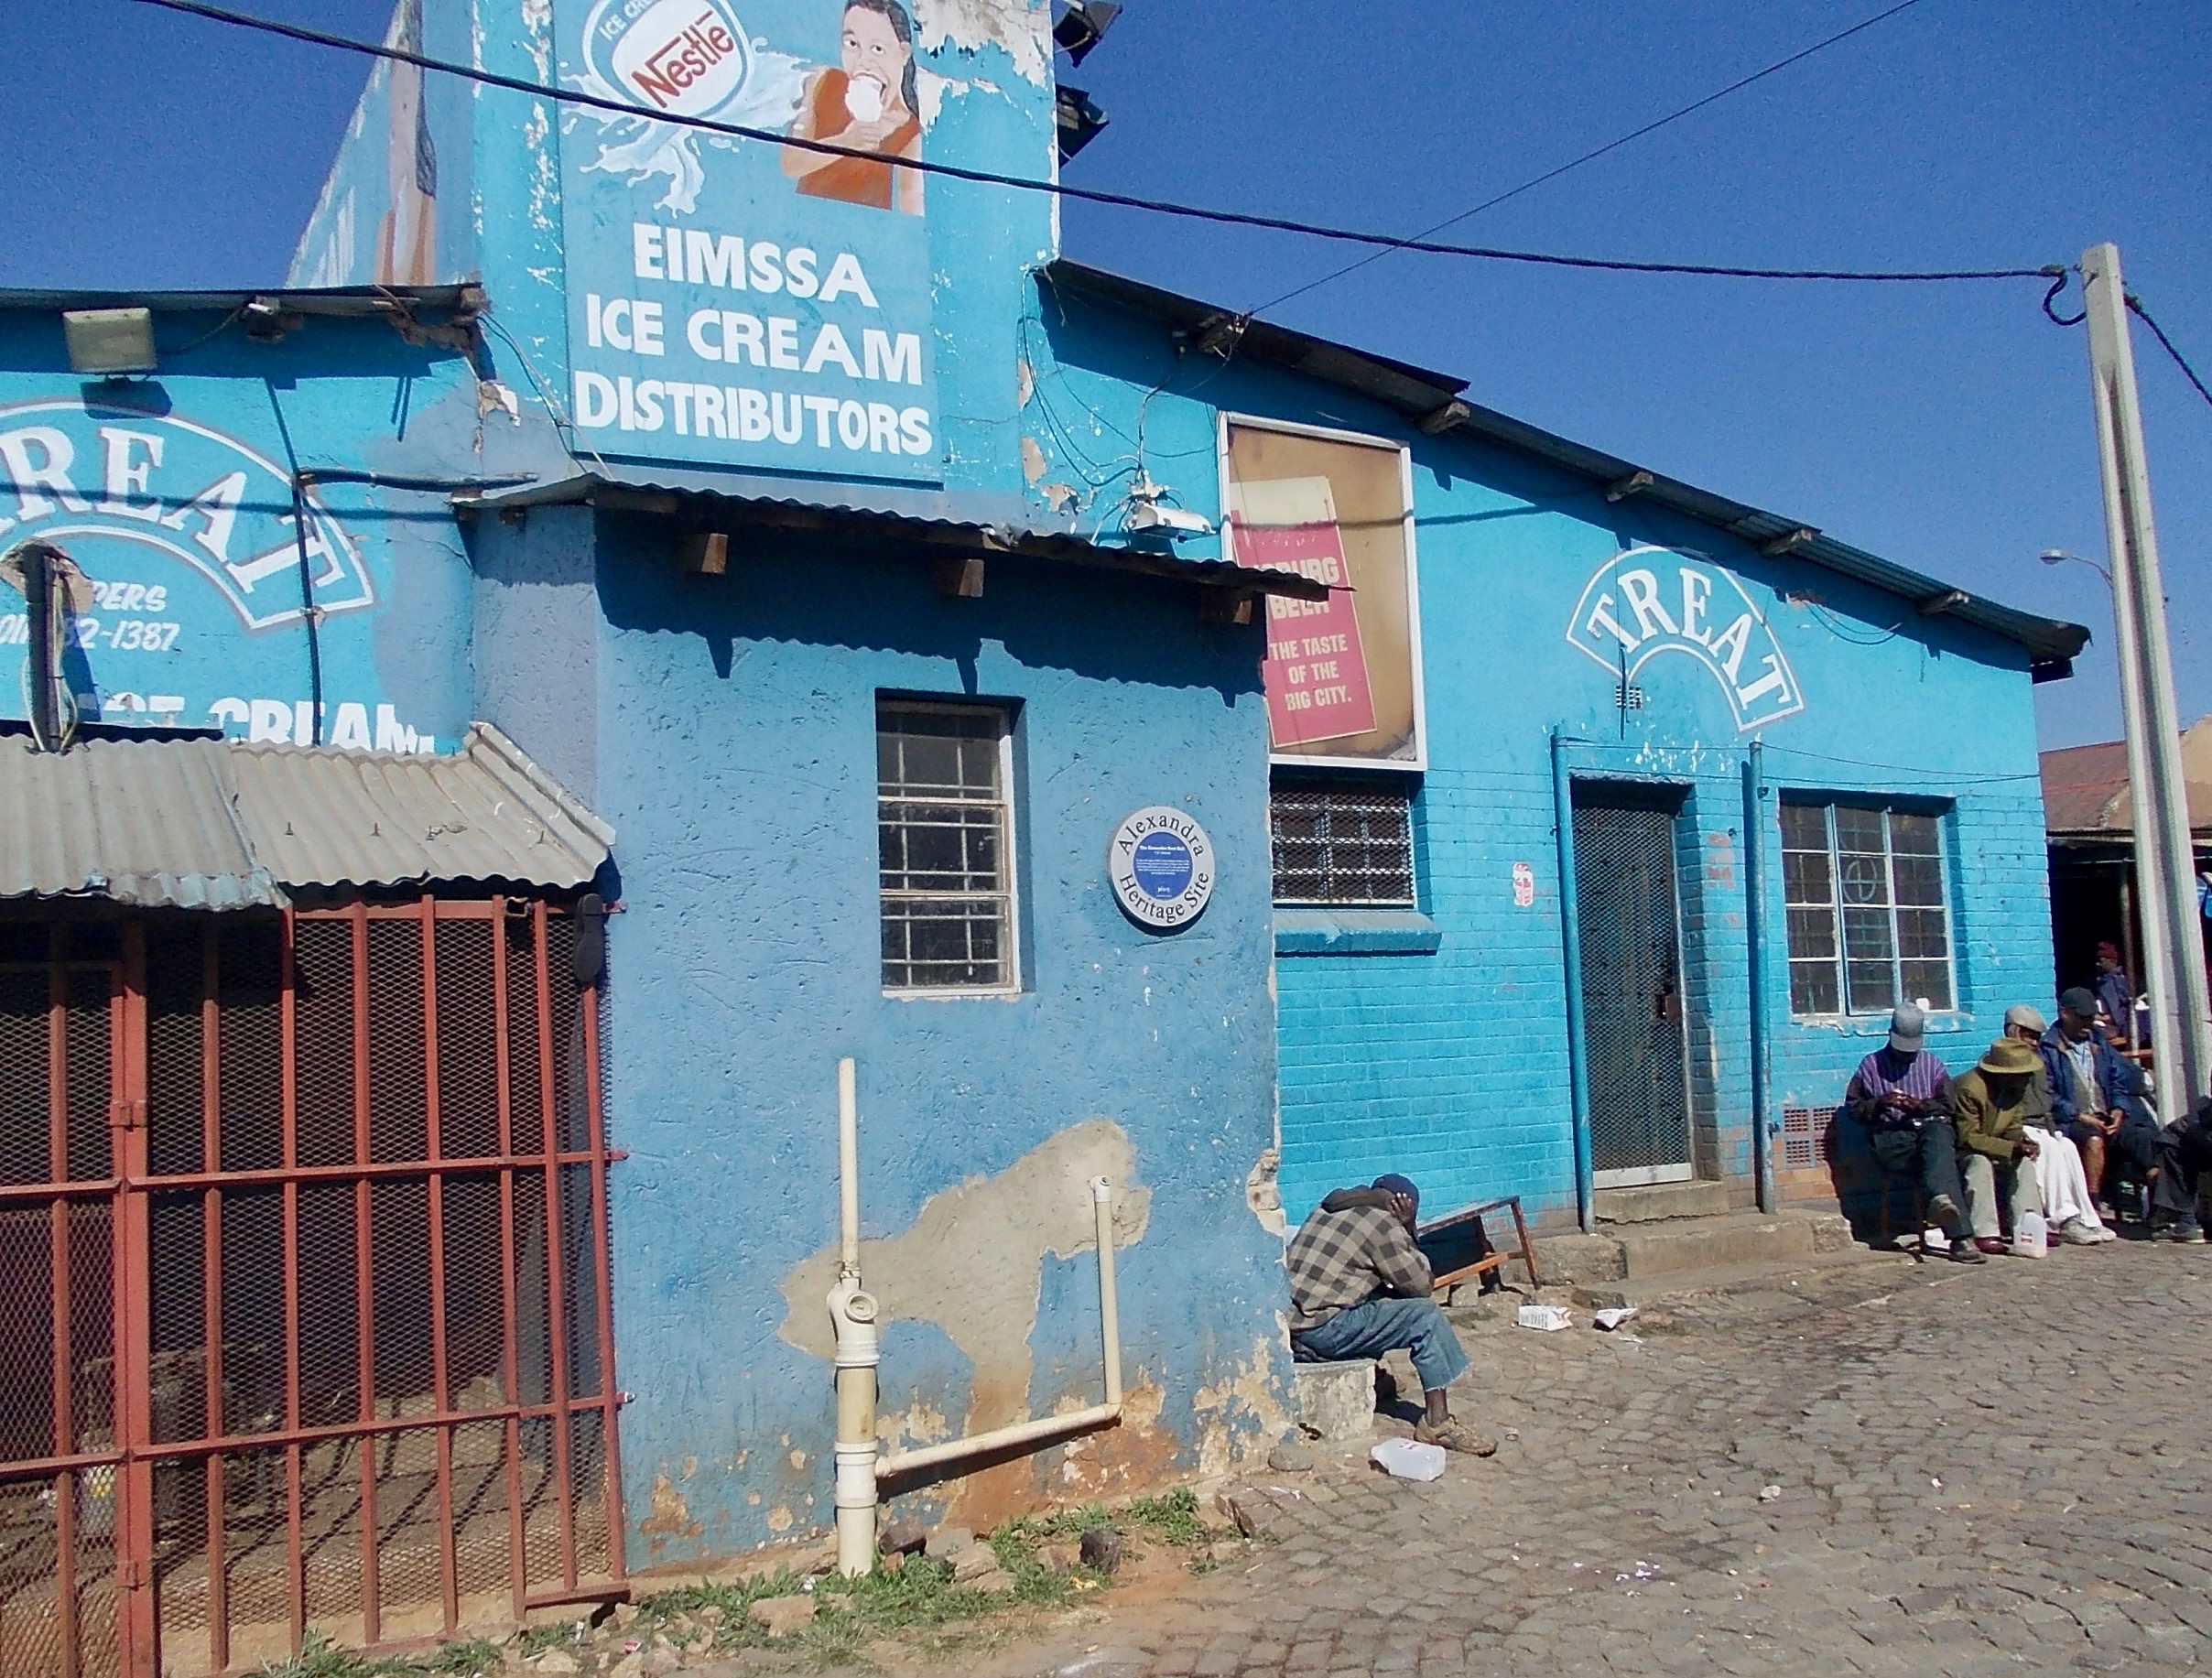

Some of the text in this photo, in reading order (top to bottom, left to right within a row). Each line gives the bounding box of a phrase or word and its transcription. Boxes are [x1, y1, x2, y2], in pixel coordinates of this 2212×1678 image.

[600, 14, 627, 41] ICE
[633, 222, 880, 308] EIMSSA
[586, 293, 923, 385] ICE CREAM
[574, 371, 934, 455] DISTRIBUTORS
[0, 427, 345, 593] REAT
[1269, 633, 1348, 661] THE TASTE
[1586, 568, 1791, 710] TREAT
[1285, 685, 1352, 711] BIG CITY.
[1288, 660, 1339, 684] OF THE
[1118, 815, 1204, 857] Alexandra
[1120, 871, 1209, 924] Heritage Site
